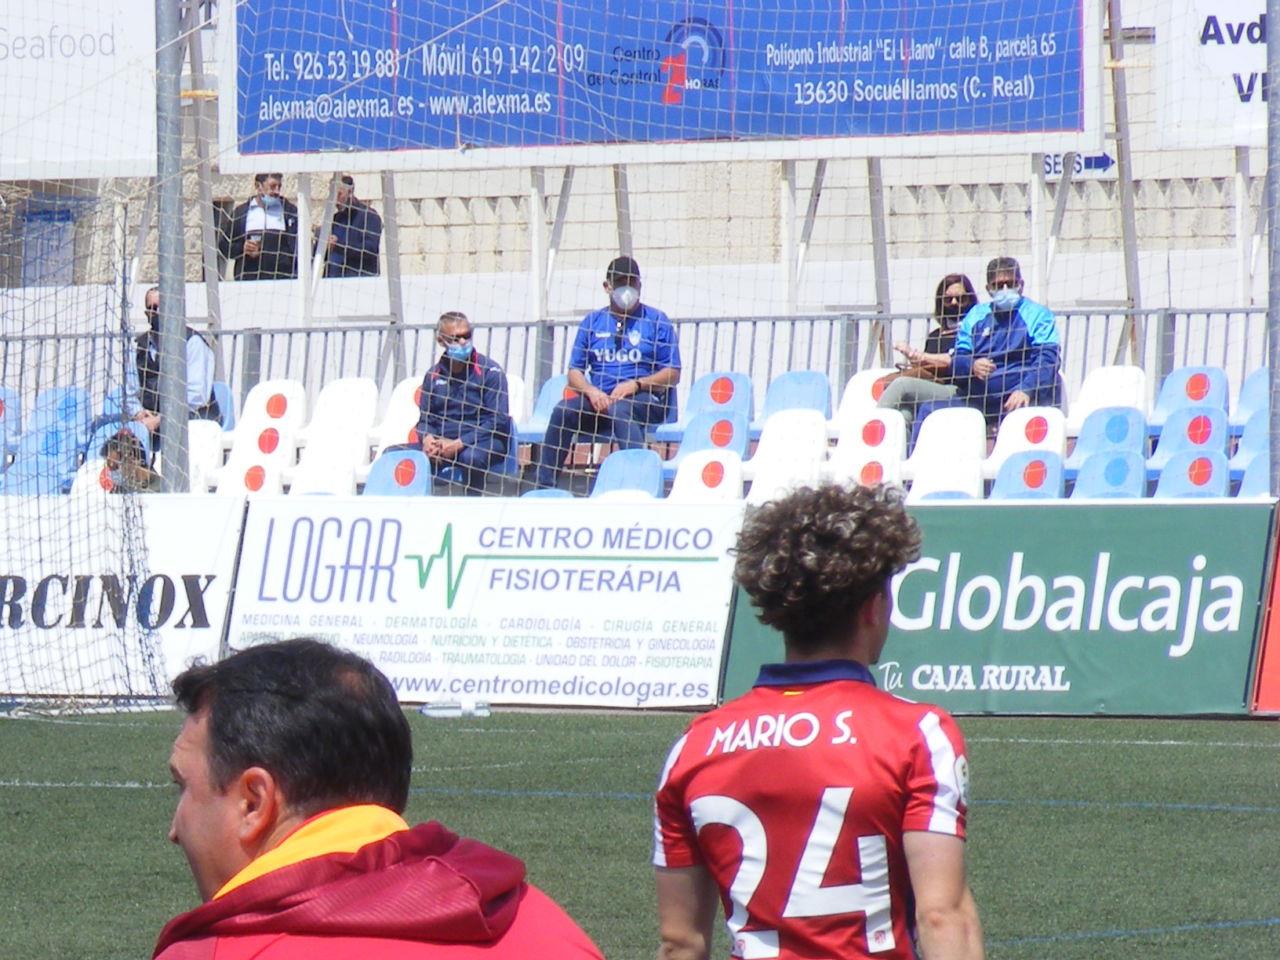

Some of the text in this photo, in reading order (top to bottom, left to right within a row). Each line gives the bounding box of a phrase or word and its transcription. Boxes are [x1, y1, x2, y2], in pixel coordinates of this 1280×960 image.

[264, 53, 289, 81] Tel.
[293, 51, 323, 81] 926
[327, 50, 347, 81] 53
[352, 50, 371, 78] 19
[422, 43, 466, 76] Móvil
[472, 47, 503, 75] 619
[510, 45, 541, 74] 142
[767, 43, 814, 70] Polígono
[818, 41, 872, 65] Industrial
[949, 36, 976, 60] calle
[996, 34, 1038, 62] parcela
[1040, 32, 1056, 56] 65
[429, 89, 551, 117] www.alexma.es
[794, 80, 848, 105] 13630
[993, 73, 1035, 100] Real)
[594, 348, 642, 363] YUGO
[478, 521, 714, 551] CENTRO MÉDICO
[257, 516, 402, 603] LOGAR
[488, 564, 682, 593] FISIOTERÁPIA
[890, 552, 1244, 658] Globalcaja
[242, 613, 300, 627] MEDICINA
[309, 614, 364, 628] GENERAL
[385, 614, 478, 629] DERMATOLOGÍA
[662, 619, 721, 633] GENERAL
[878, 661, 1071, 691] Tu CAJA RURAL
[706, 709, 858, 756] MARIO S.
[689, 786, 896, 960] 24
